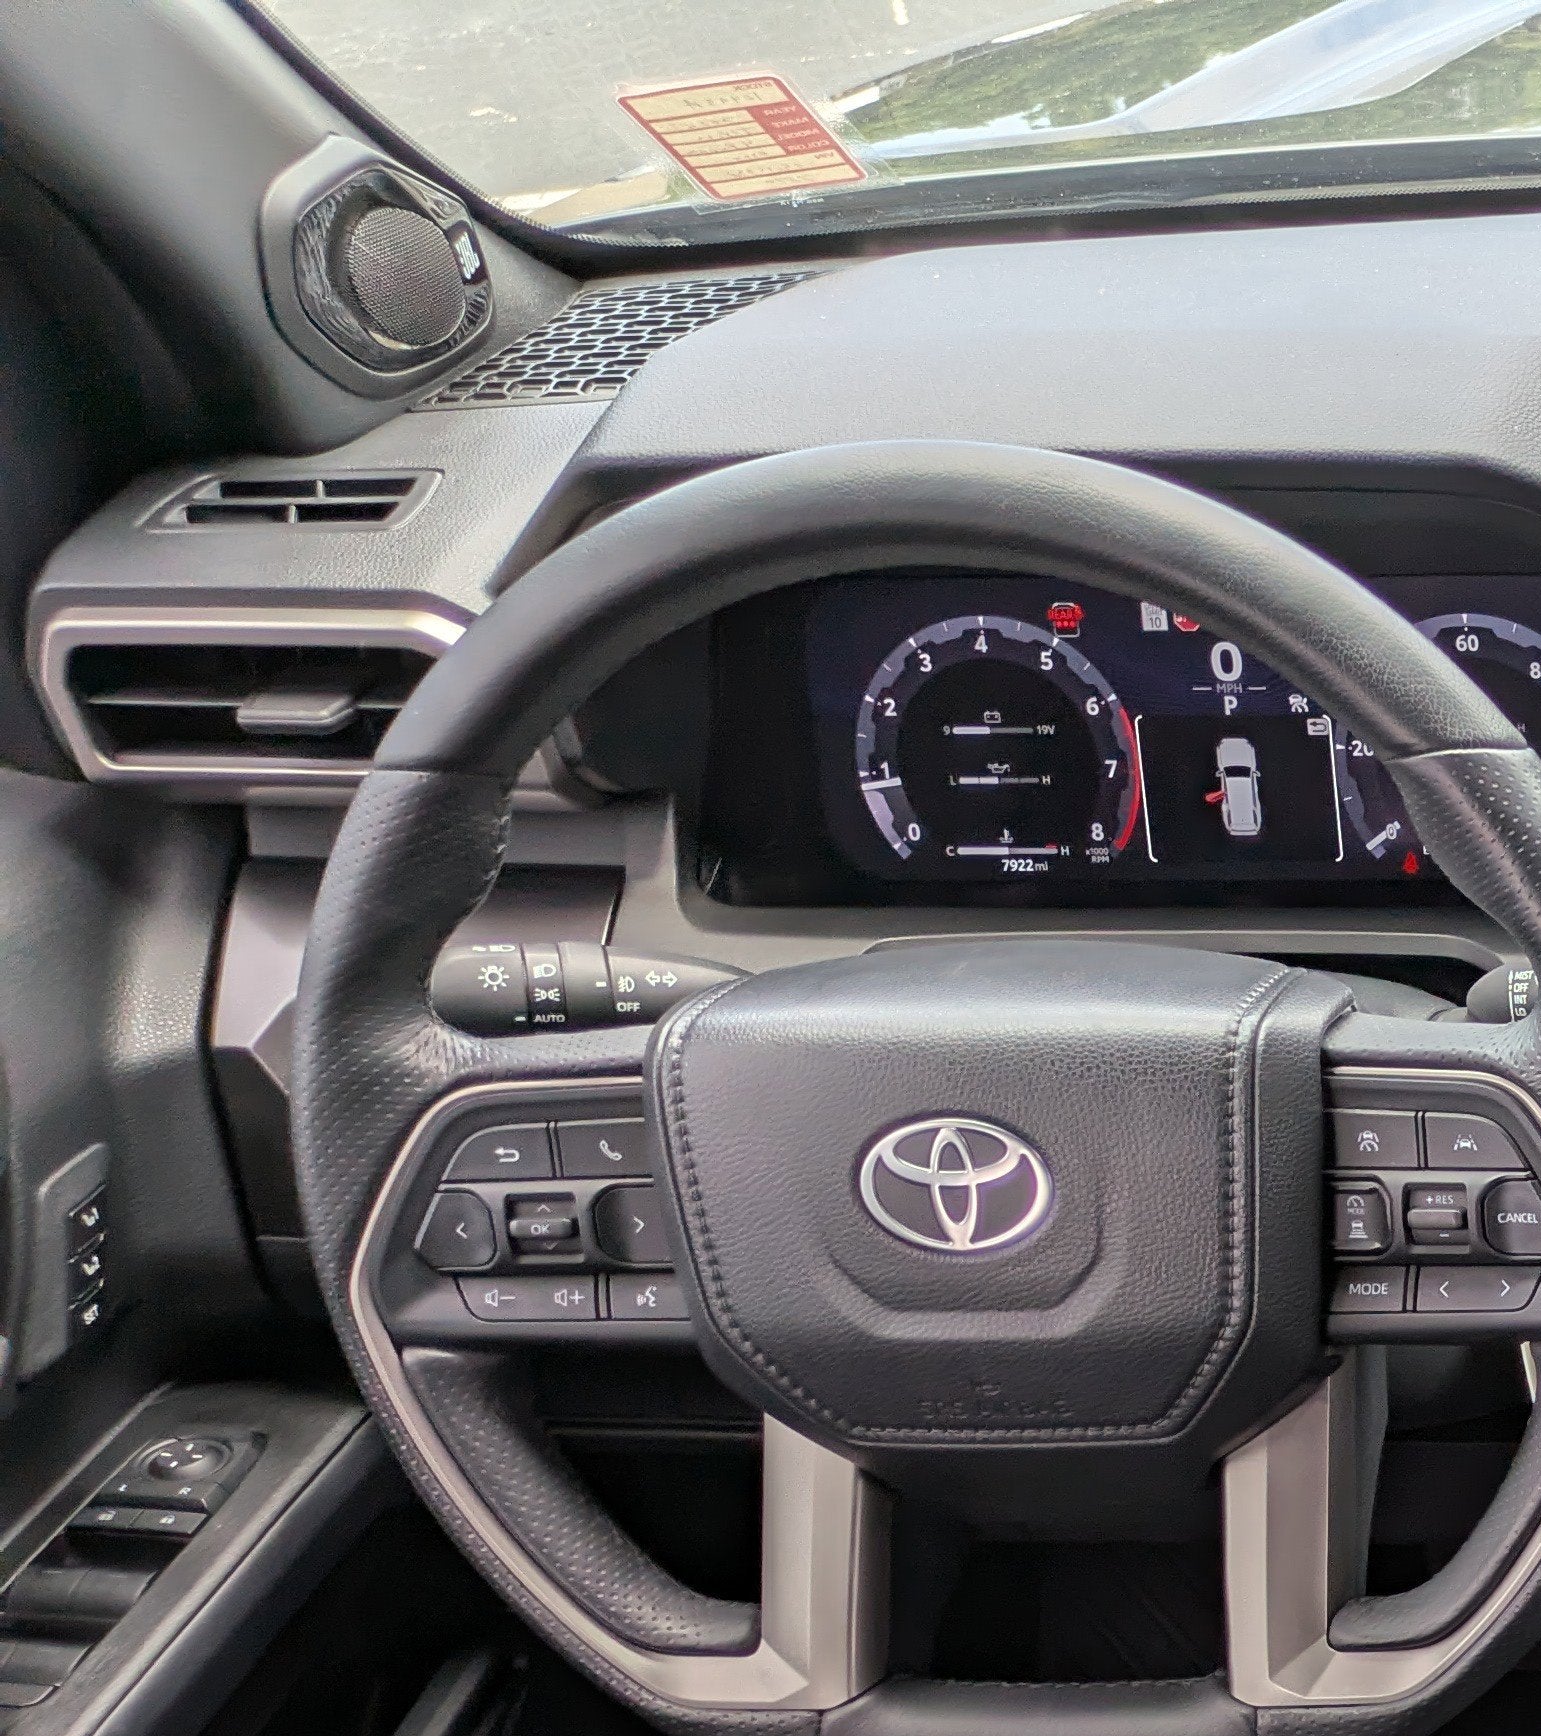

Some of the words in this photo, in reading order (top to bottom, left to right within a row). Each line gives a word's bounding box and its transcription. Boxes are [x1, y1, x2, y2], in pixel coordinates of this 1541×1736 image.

[974, 633, 988, 653] 4
[1456, 634, 1480, 653] 60
[919, 653, 932, 672] 3
[1040, 651, 1054, 670] 5
[1210, 641, 1243, 682] 0
[1216, 683, 1243, 694] MPH
[884, 699, 898, 716] 2
[1085, 697, 1099, 715] 6
[1223, 695, 1238, 716] P
[1036, 725, 1056, 736] 19V
[880, 762, 890, 779] 1
[1104, 760, 1117, 778] 7
[907, 823, 921, 841] 0
[1091, 822, 1105, 841] 8
[1513, 982, 1530, 993] OFF
[616, 1001, 641, 1013] OFF
[533, 1013, 566, 1024] AUTO
[1497, 1212, 1539, 1224] CANCEL
[530, 1222, 550, 1235] OK
[1348, 1282, 1389, 1296] MODE
